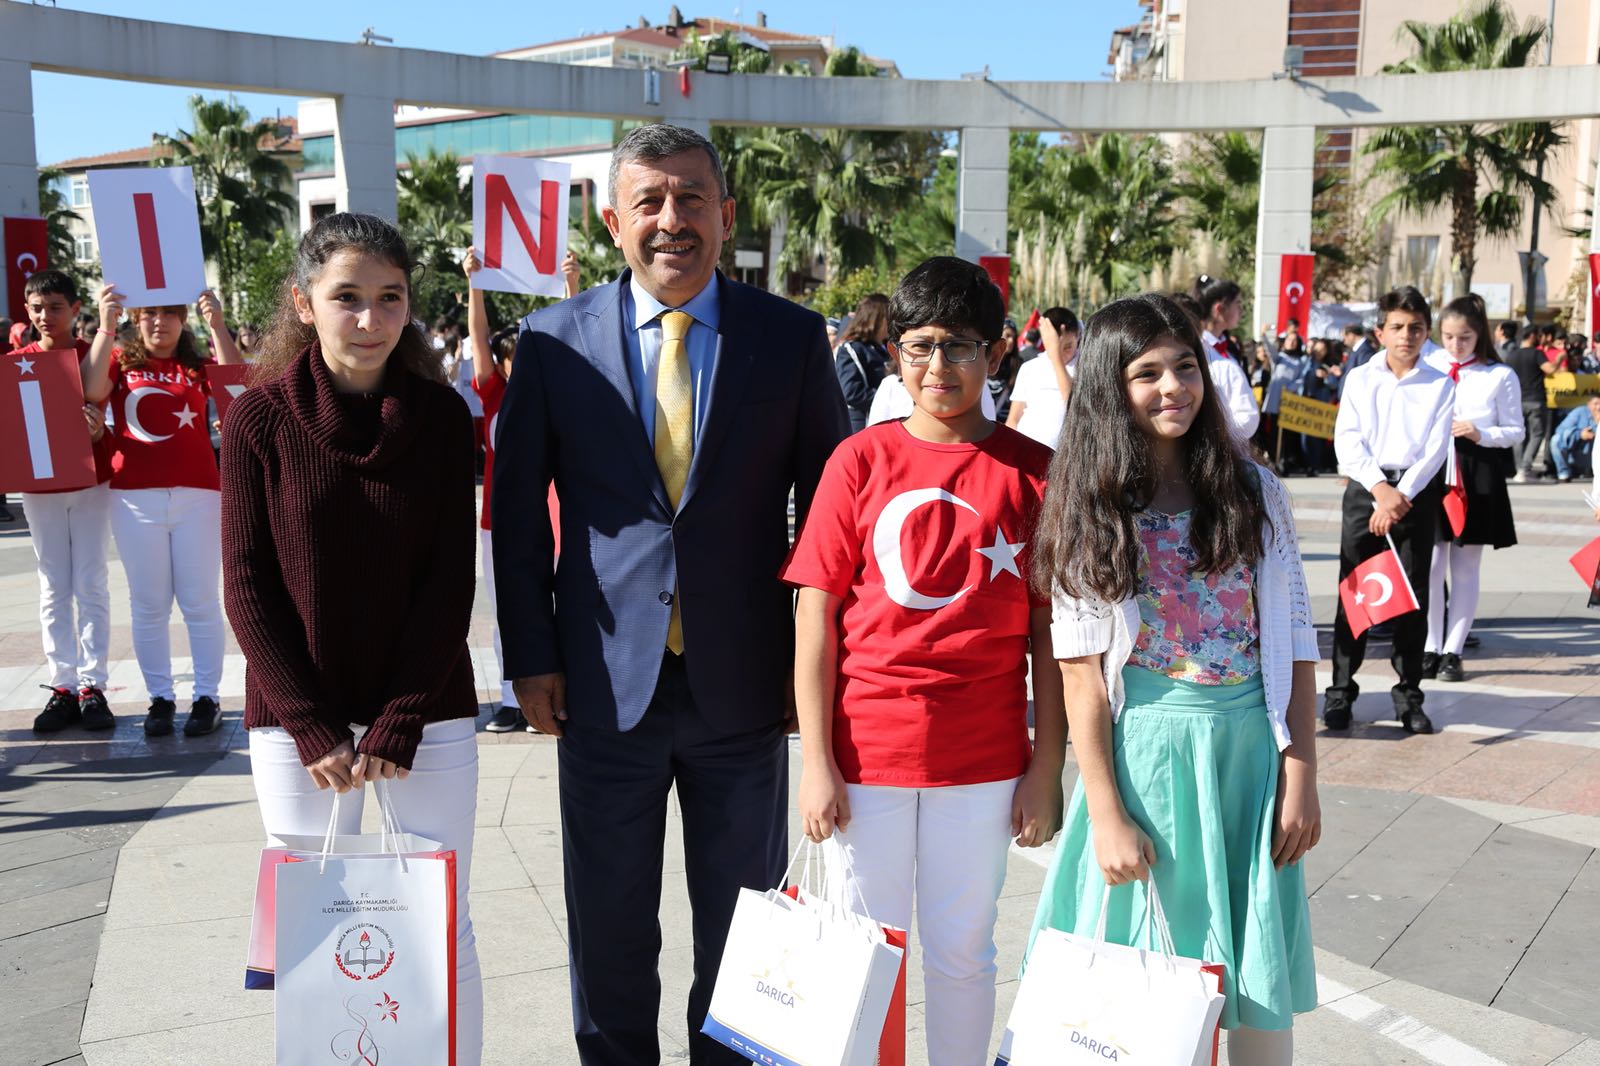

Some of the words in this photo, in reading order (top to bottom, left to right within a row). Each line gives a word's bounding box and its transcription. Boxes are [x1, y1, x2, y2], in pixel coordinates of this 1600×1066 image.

[132, 192, 166, 290] I
[483, 173, 560, 276] N
[755, 980, 795, 1009] DARICA
[1069, 1030, 1119, 1063] DARICA
